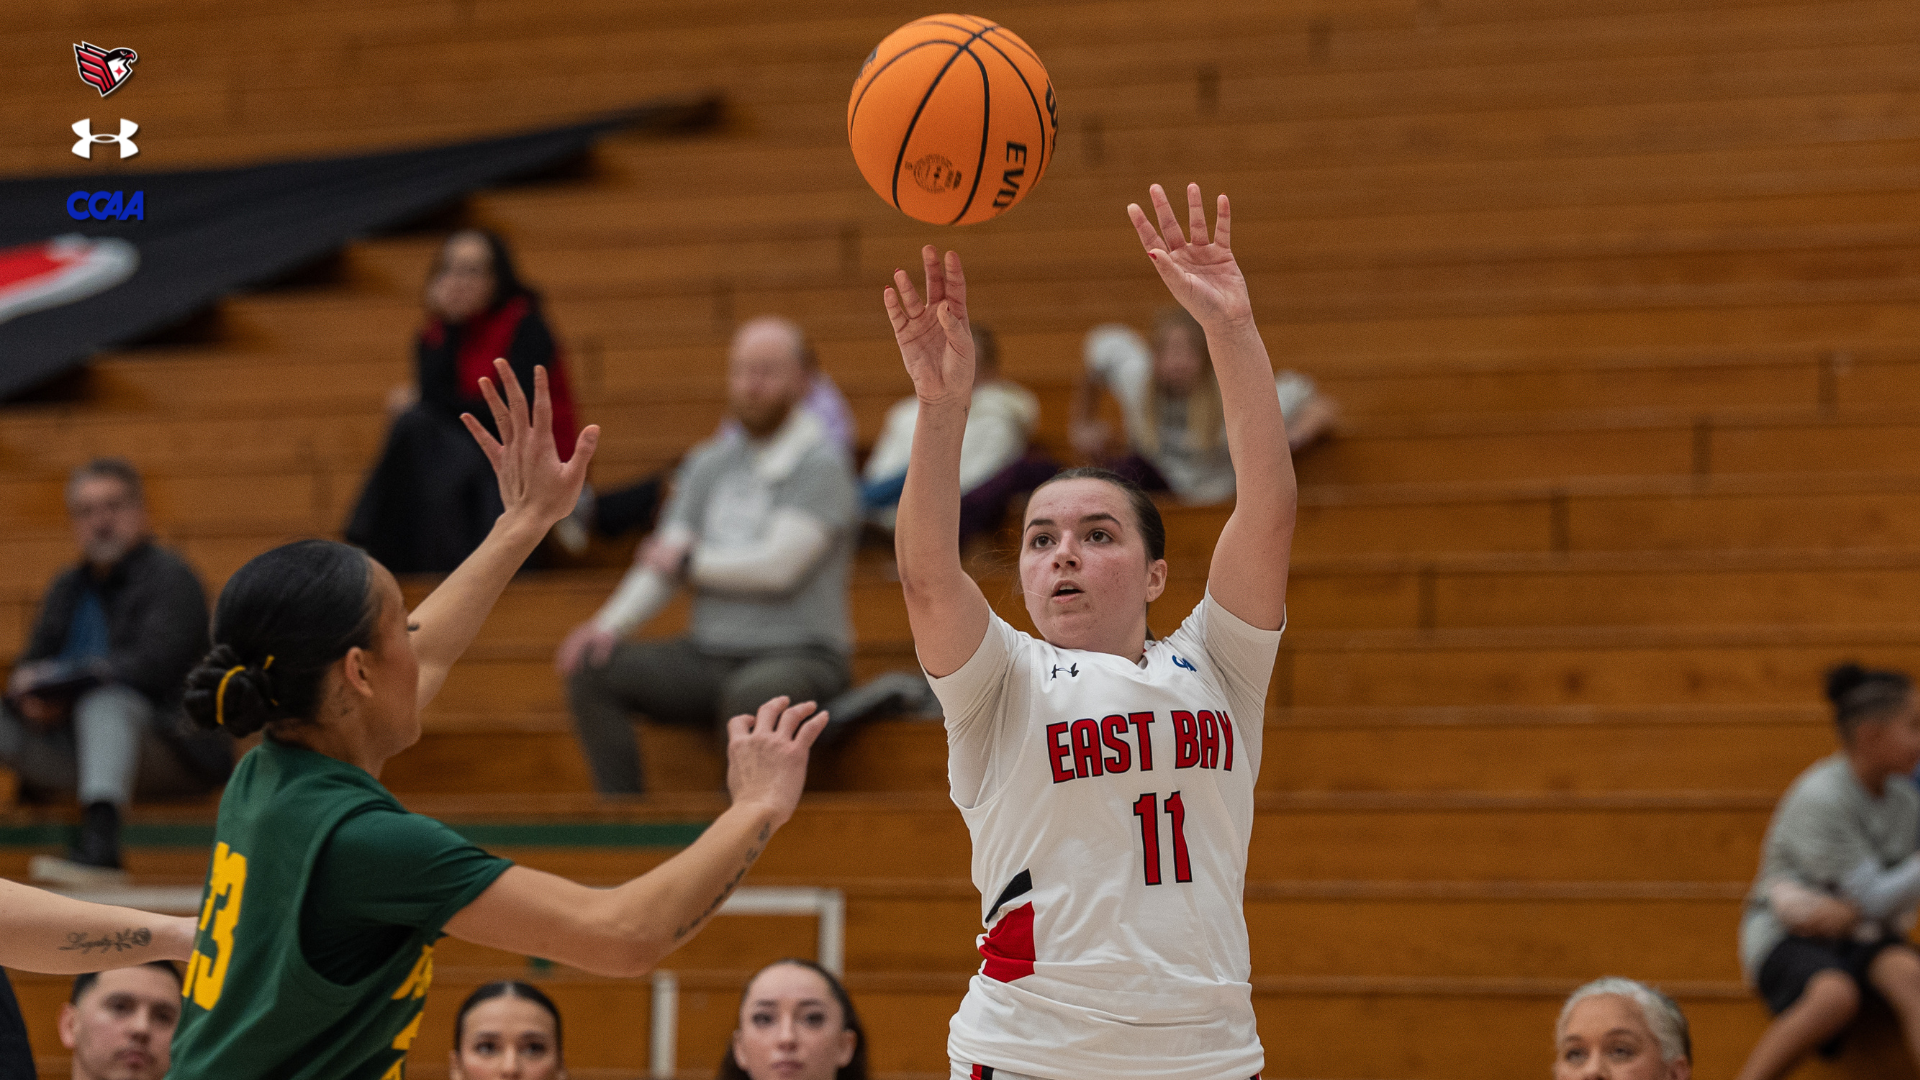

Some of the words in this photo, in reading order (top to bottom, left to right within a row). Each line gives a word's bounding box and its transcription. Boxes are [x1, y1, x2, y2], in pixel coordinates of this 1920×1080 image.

[1046, 711, 1155, 784] EAST
[1170, 710, 1234, 771] BAY
[1133, 790, 1193, 886] 11
